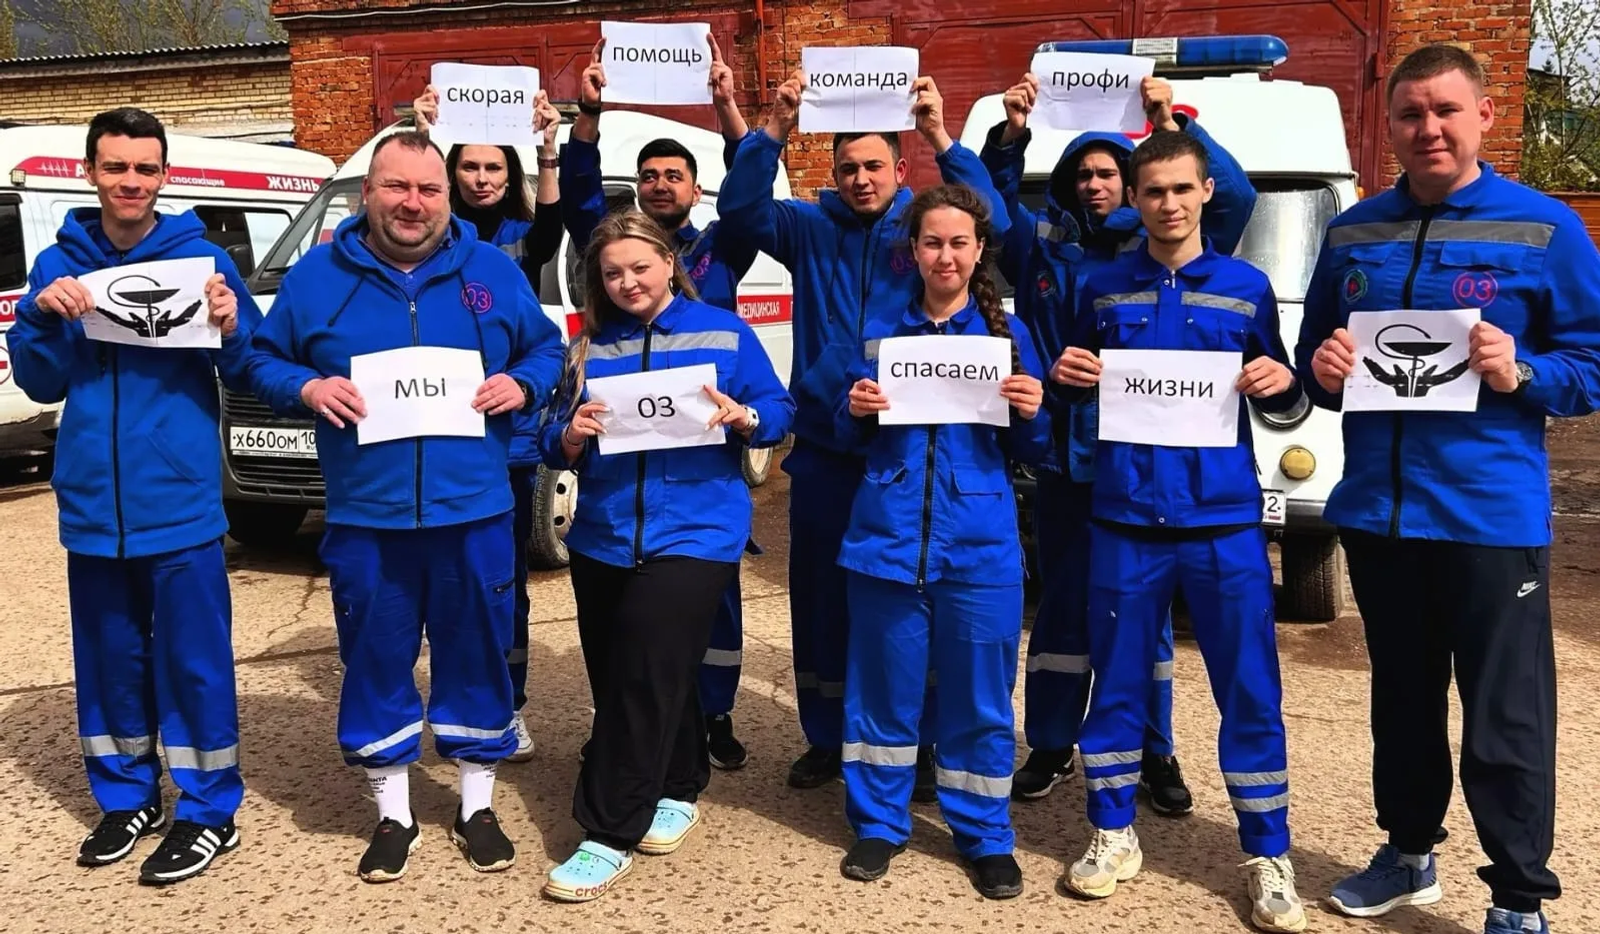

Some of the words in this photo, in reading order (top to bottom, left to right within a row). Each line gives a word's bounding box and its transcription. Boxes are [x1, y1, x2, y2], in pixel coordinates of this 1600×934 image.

[613, 46, 703, 68] помощь
[809, 71, 909, 92] команда
[1052, 67, 1130, 94] профи
[447, 86, 525, 109] скорая
[266, 175, 321, 193] ЖИЗНЬ
[465, 288, 489, 309] 03
[1458, 277, 1492, 301] 03
[890, 361, 999, 381] спасаем
[394, 377, 447, 399] мы
[1124, 377, 1214, 399] жизни
